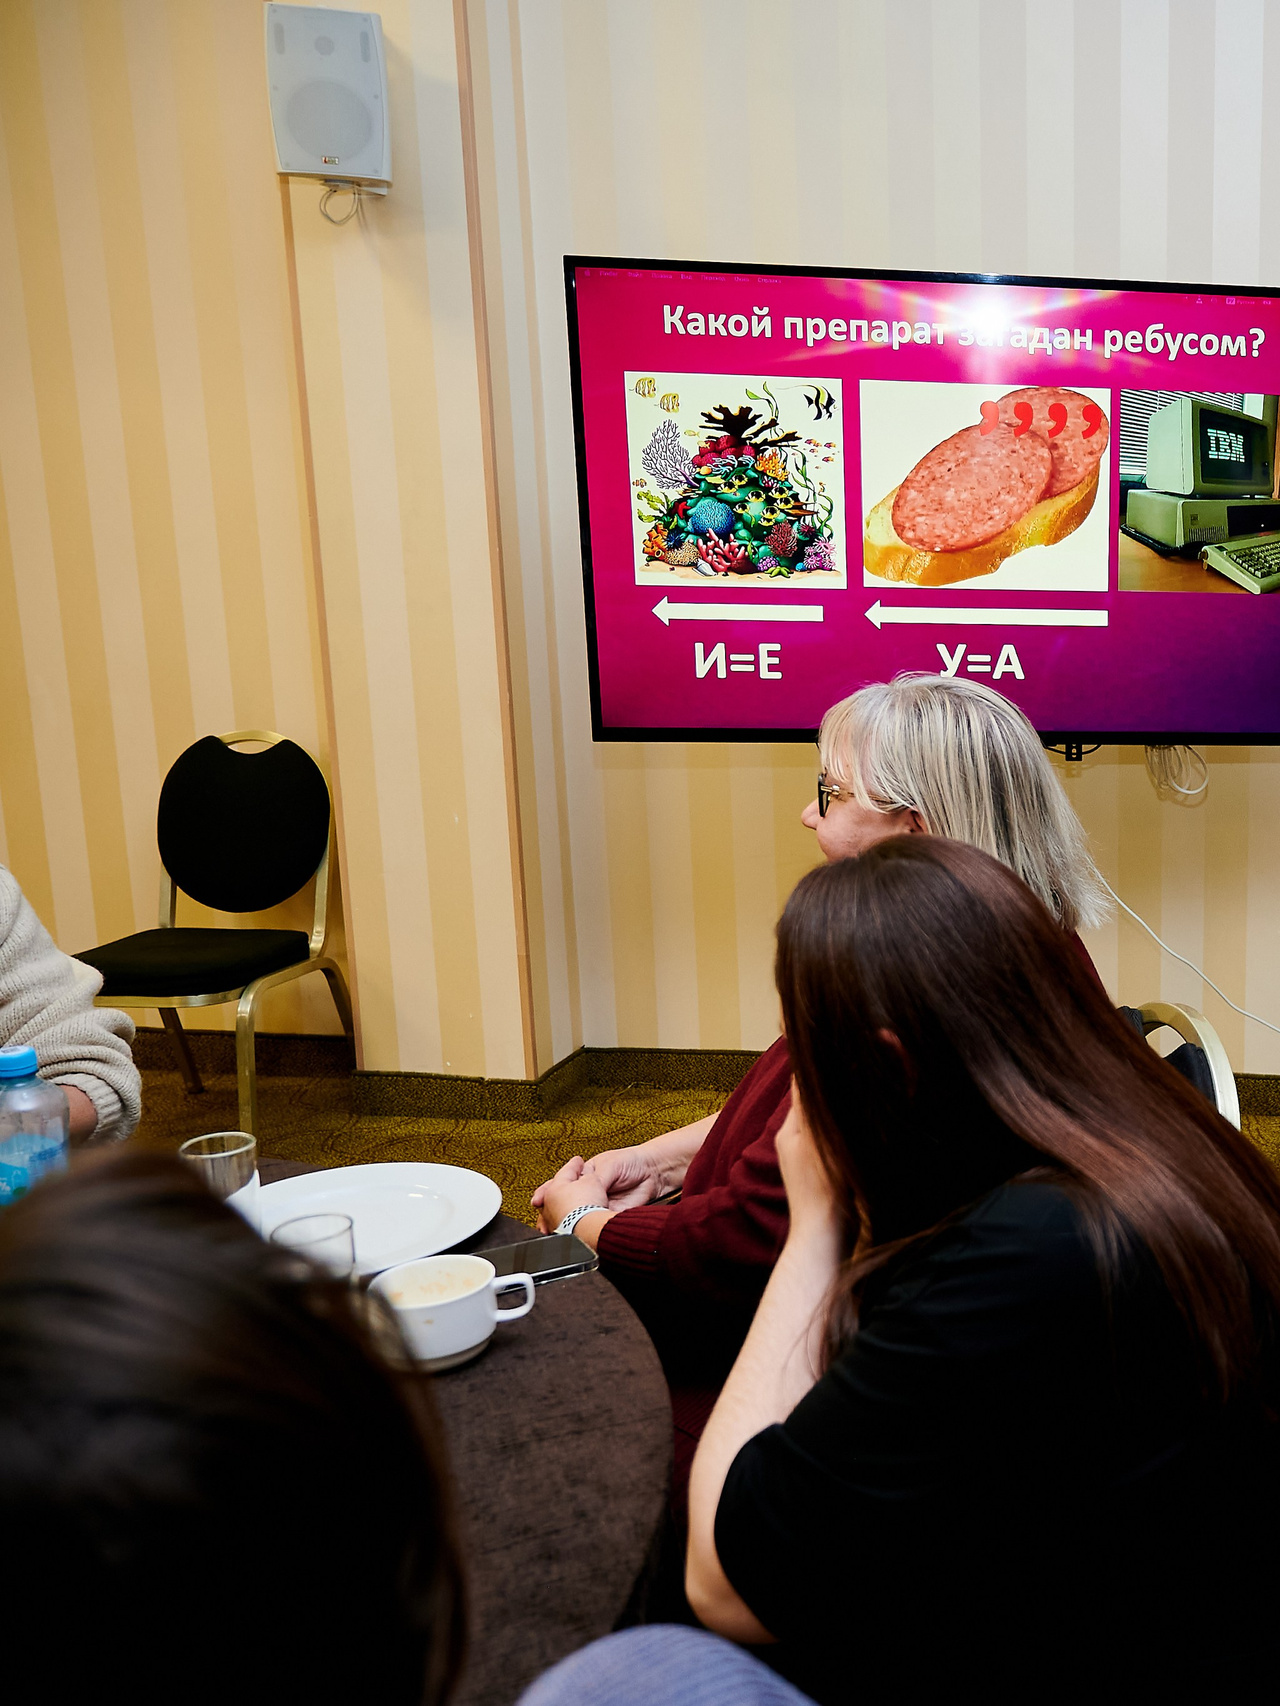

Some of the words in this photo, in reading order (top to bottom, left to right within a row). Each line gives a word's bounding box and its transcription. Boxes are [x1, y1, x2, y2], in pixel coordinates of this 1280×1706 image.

[662, 304, 772, 338] Какой
[784, 317, 945, 350] препарат
[1104, 324, 1266, 361] ребусом?
[1207, 428, 1245, 462] IBM
[694, 642, 783, 680] И=Е
